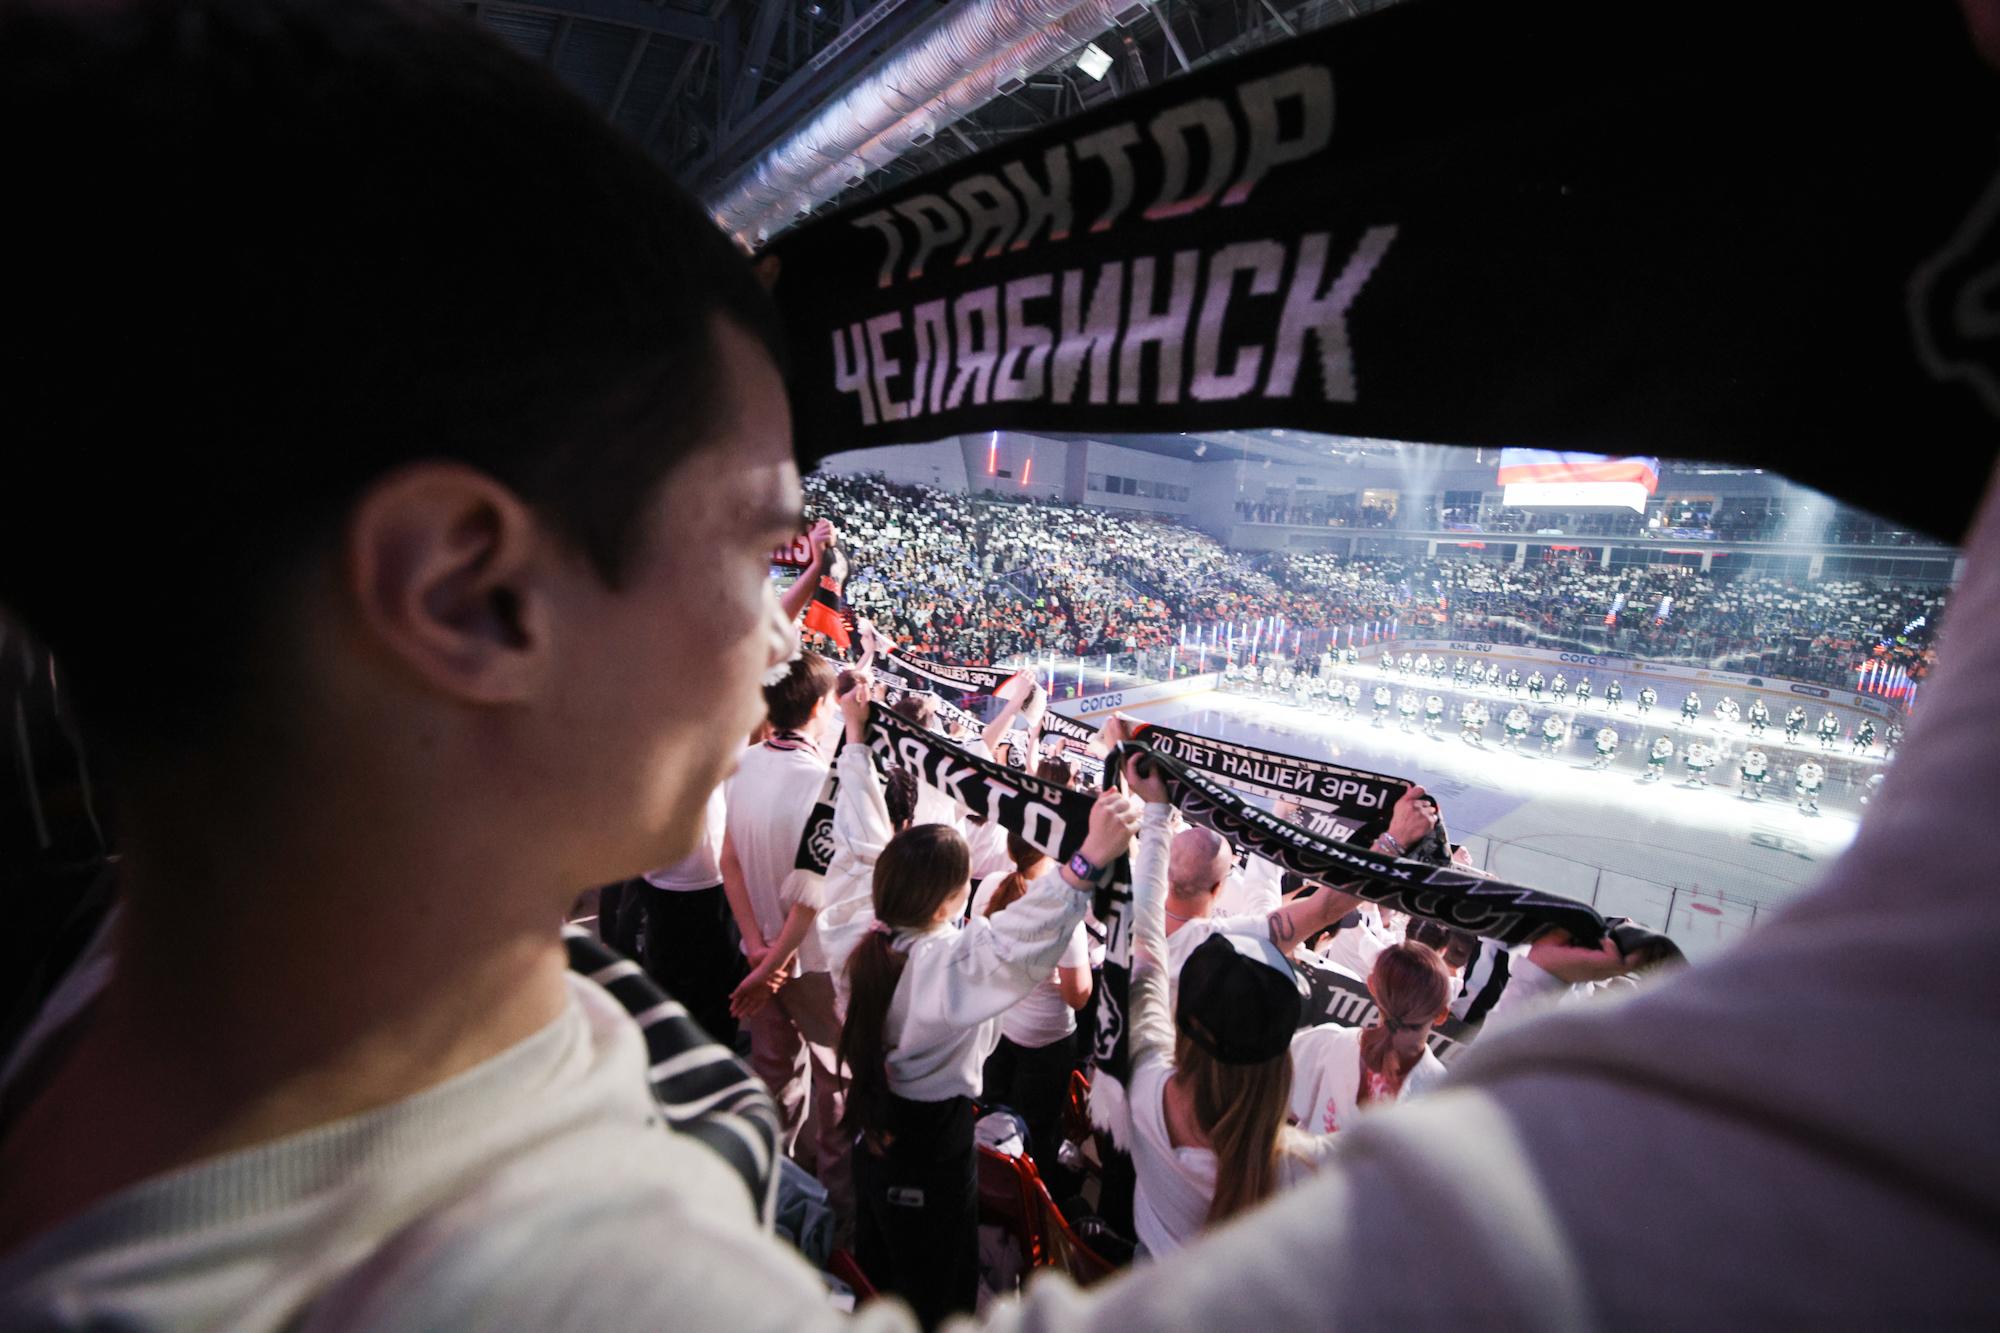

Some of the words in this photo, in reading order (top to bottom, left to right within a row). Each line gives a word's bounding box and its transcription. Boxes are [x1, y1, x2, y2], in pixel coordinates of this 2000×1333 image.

[852, 63, 1335, 288] ТРАКТОР
[832, 224, 1398, 426] ЧЕЛЯБИНСК
[1151, 732, 1173, 755] 70
[1176, 740, 1216, 767] ЛЕТ
[1222, 753, 1314, 793] НАШЕЙ
[1320, 776, 1388, 809] ЭРЫ
